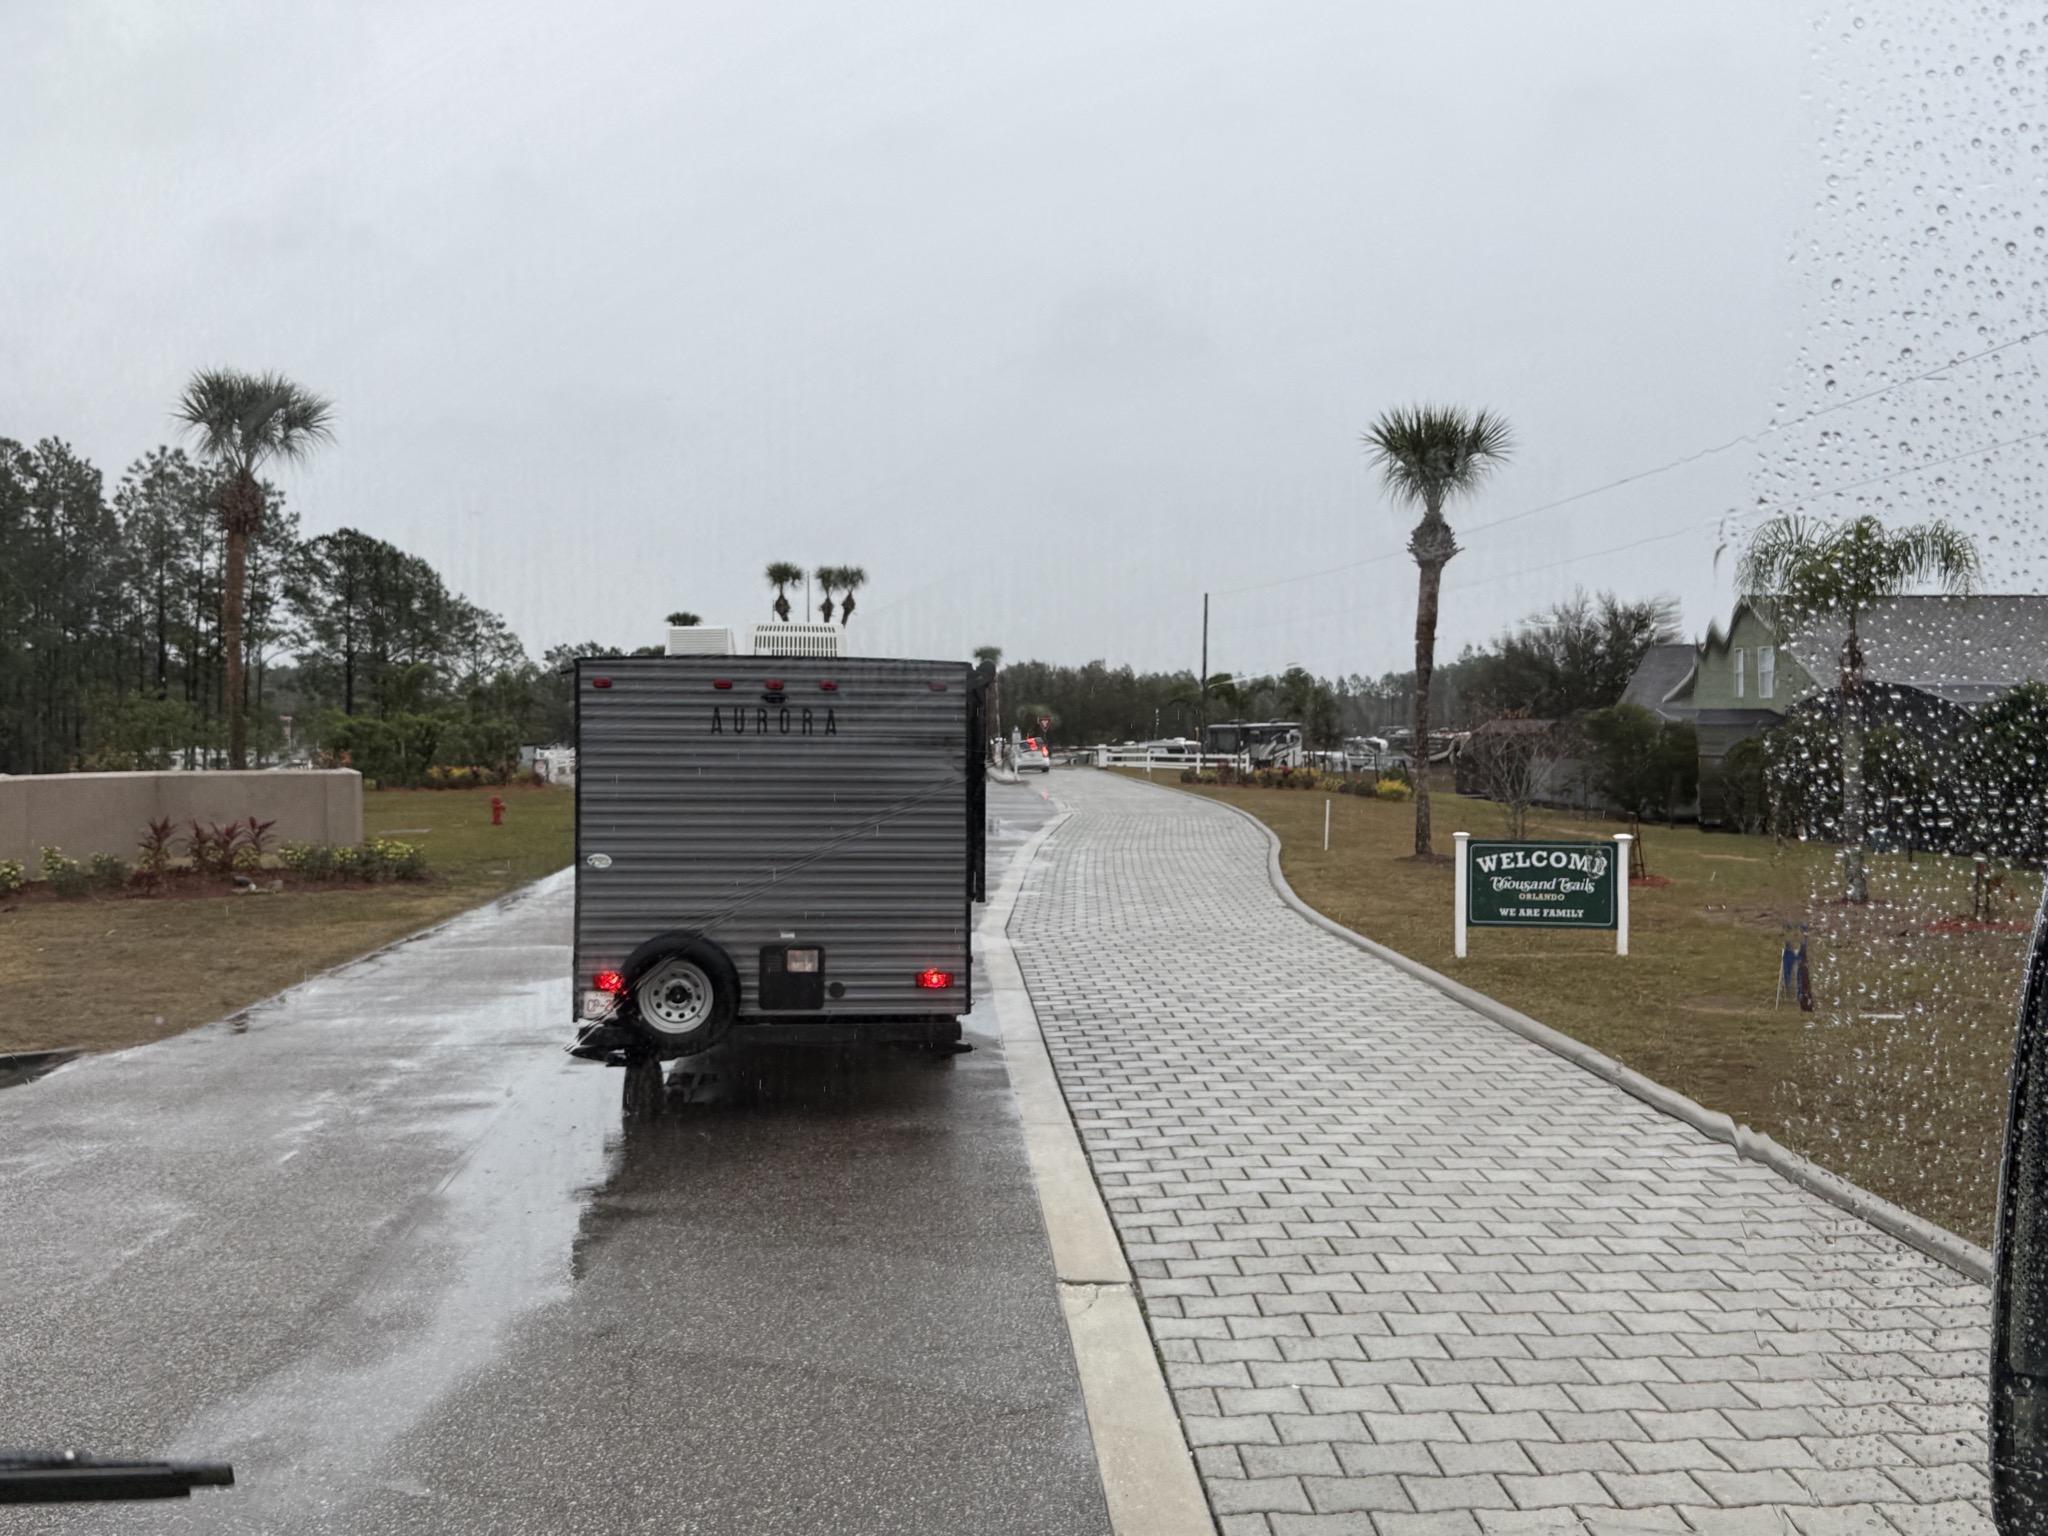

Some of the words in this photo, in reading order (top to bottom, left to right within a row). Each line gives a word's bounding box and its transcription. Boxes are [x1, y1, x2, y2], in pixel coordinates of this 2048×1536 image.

[710, 706, 837, 735] AURORA
[1490, 876, 1557, 892] Thousand
[1557, 877, 1596, 894] Trails
[1518, 893, 1565, 901] ORLANDO
[1499, 908, 1516, 917] WE
[1518, 908, 1540, 917] ARE
[1542, 908, 1584, 918] FAMILY
